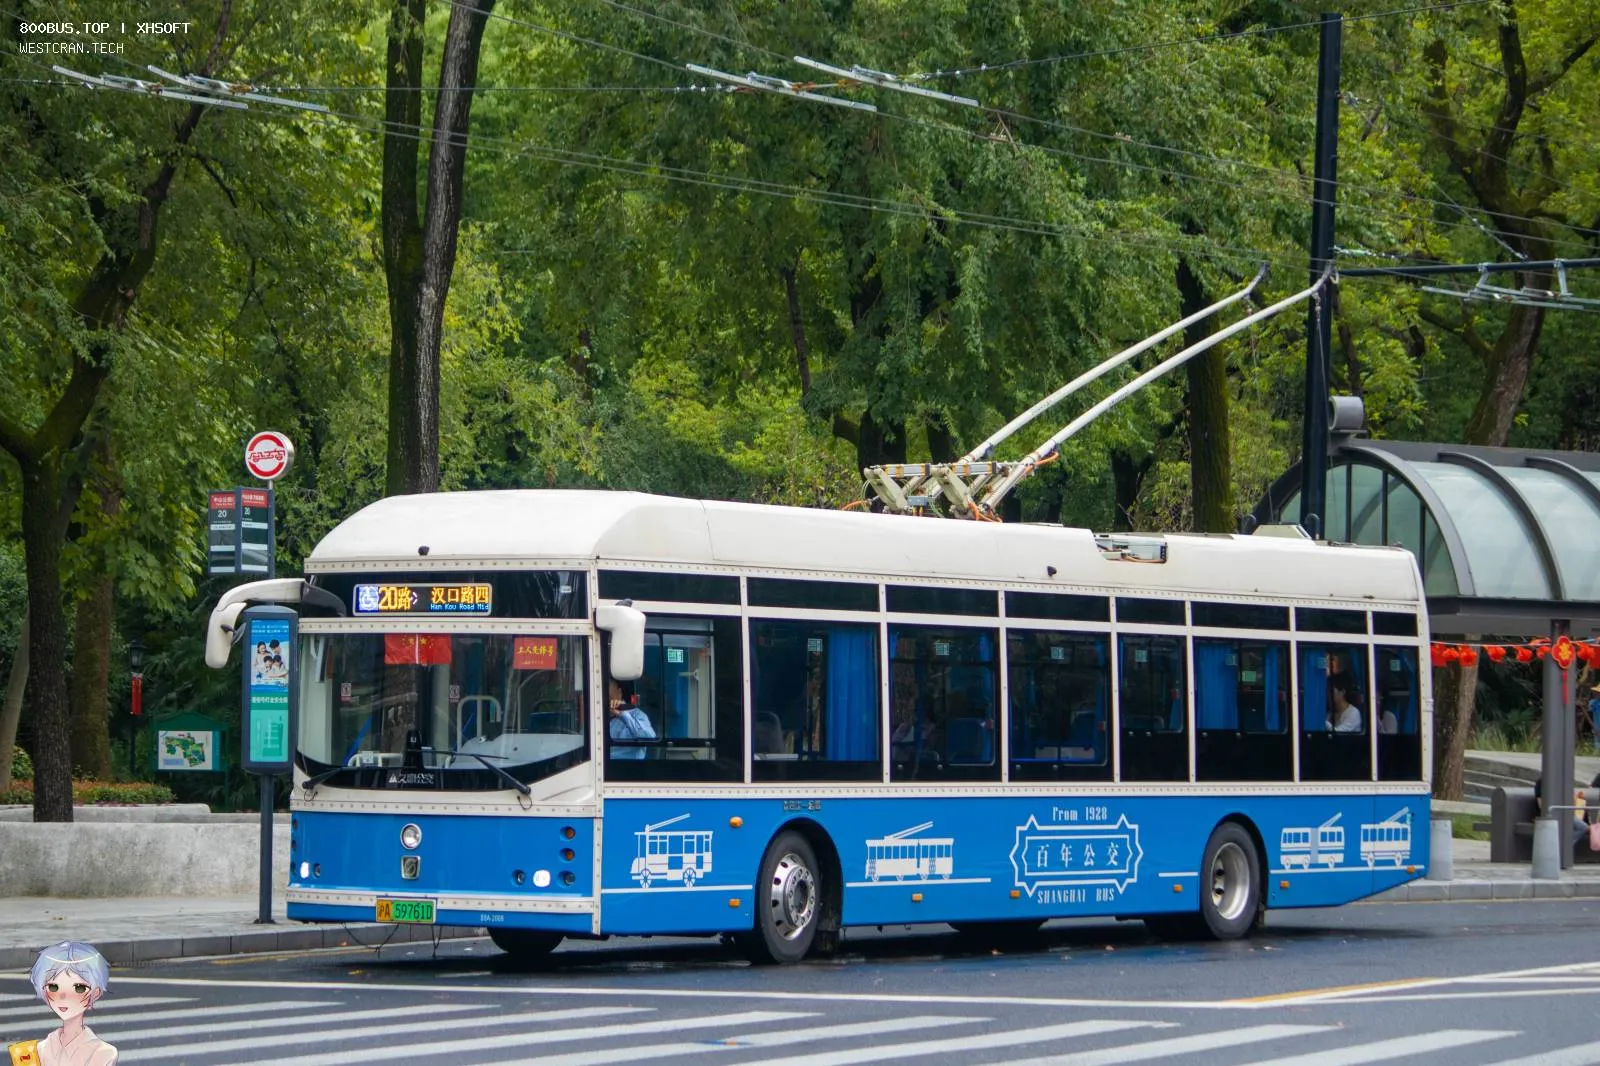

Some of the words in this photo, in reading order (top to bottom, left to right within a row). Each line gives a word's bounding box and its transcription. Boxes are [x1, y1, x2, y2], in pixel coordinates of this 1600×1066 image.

[217, 510, 228, 518] 20
[378, 586, 412, 610] 20路
[431, 586, 489, 604] 汉口路四
[1052, 806, 1078, 821] From
[1085, 806, 1108, 821] 1928
[1036, 841, 1119, 868] 百年公交
[1037, 887, 1086, 905] SHANGHAI
[1096, 887, 1115, 902] BUS
